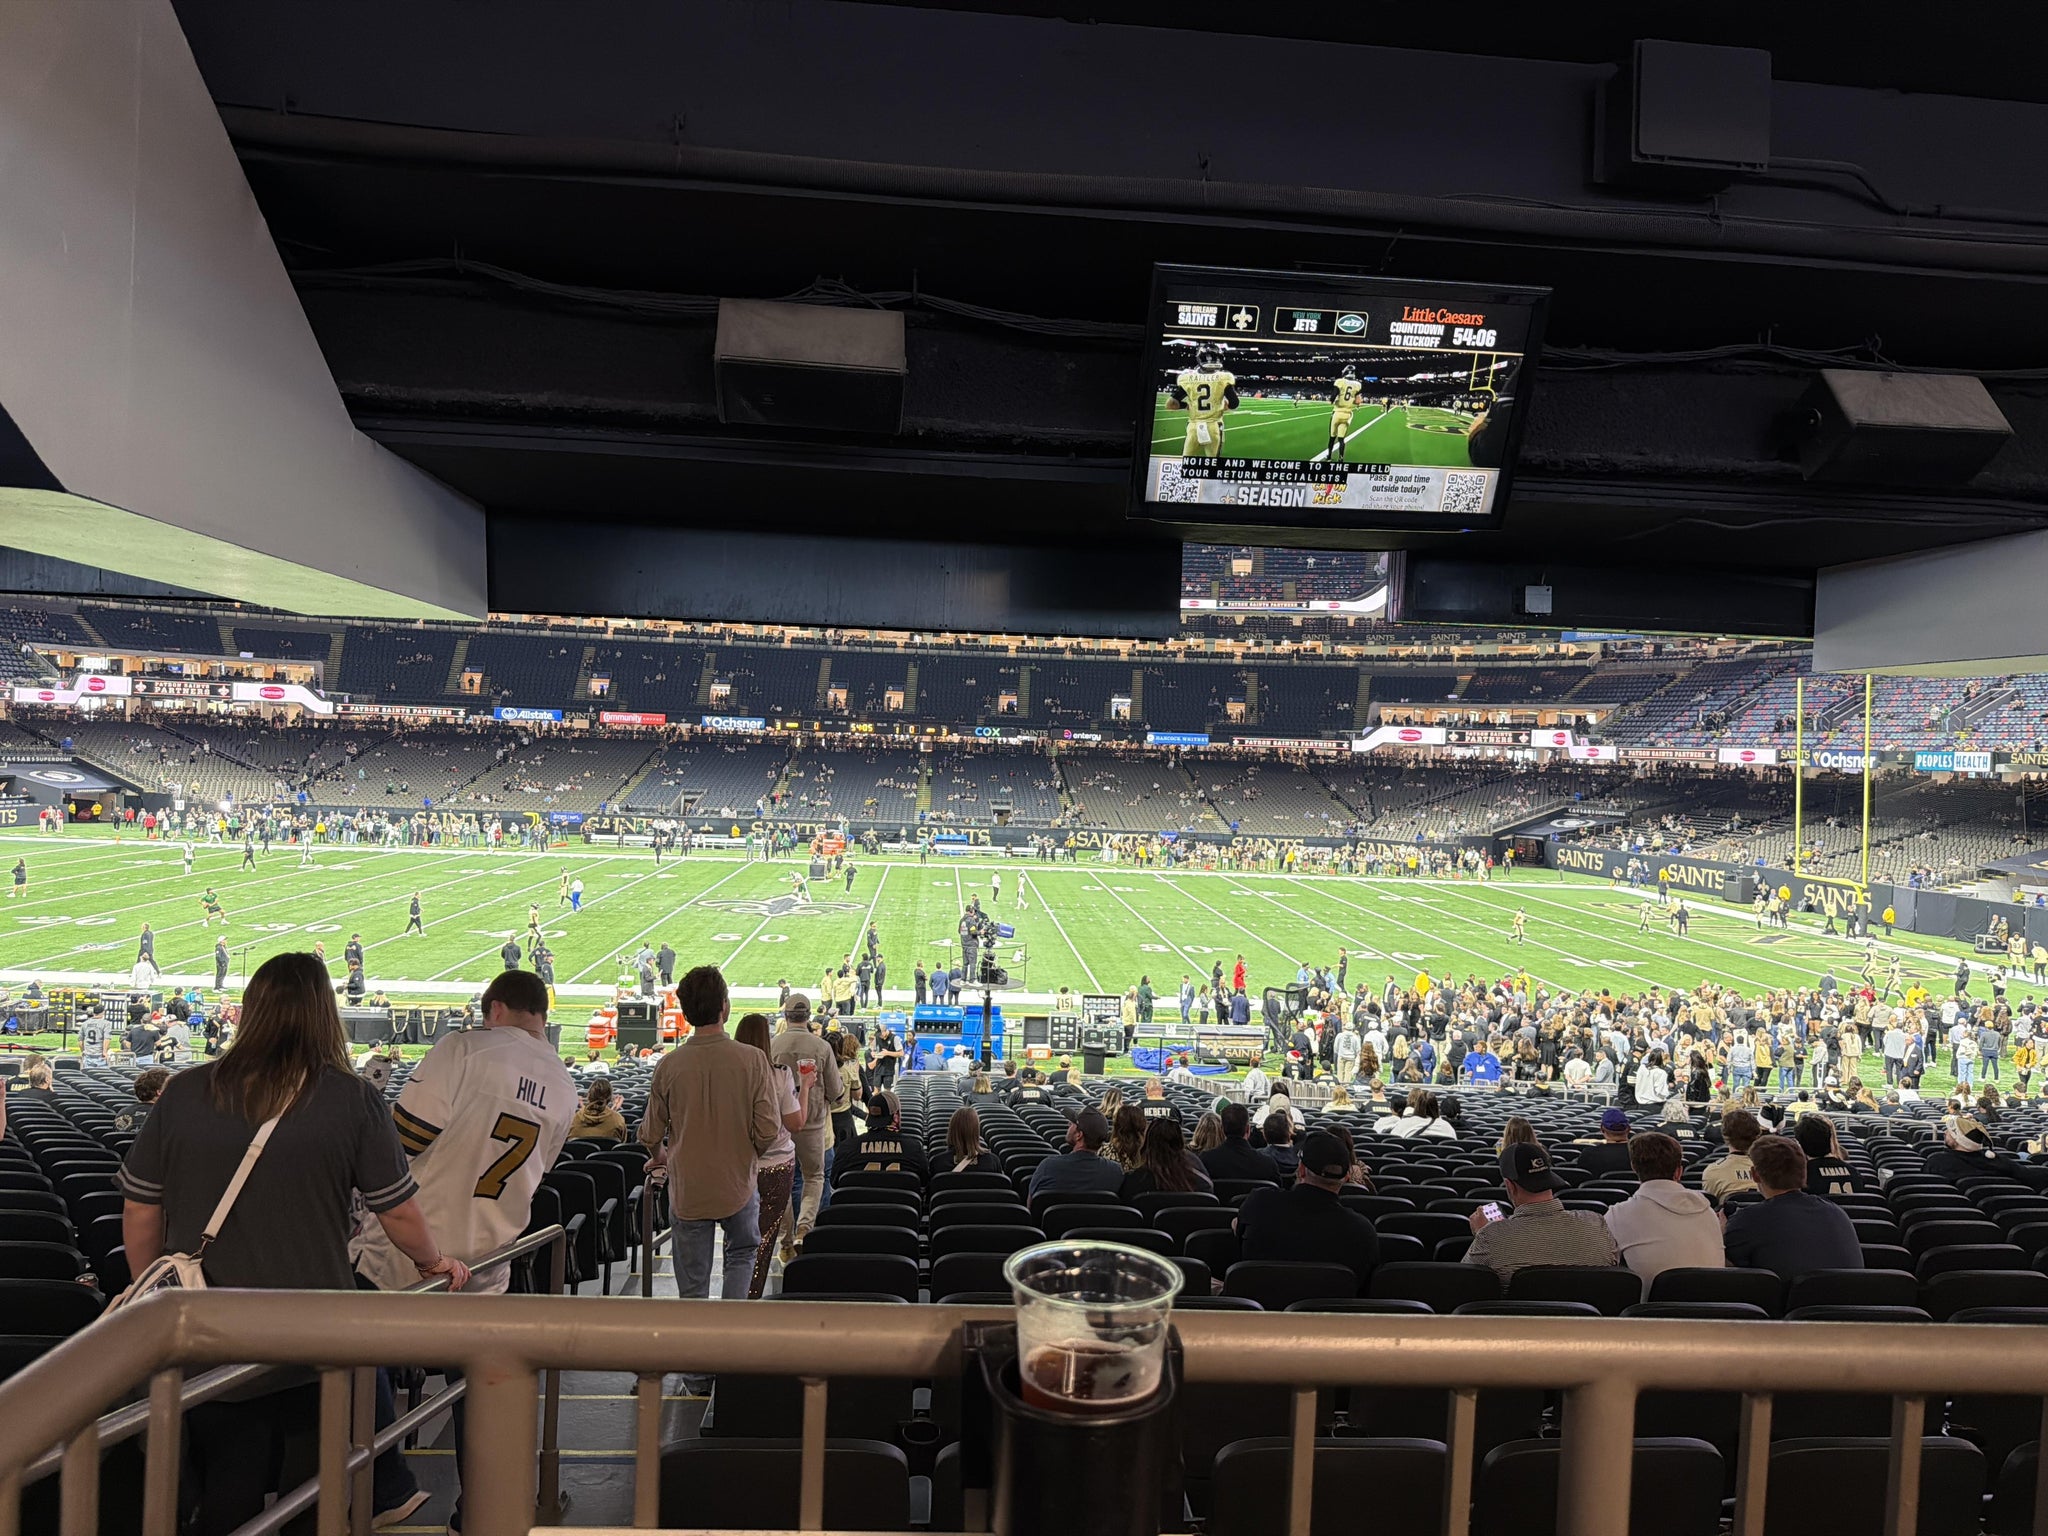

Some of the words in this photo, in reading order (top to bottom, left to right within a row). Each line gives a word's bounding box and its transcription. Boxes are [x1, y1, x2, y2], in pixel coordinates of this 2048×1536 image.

[1178, 312, 1217, 327] SAINTS
[1292, 311, 1305, 320] NEW
[1305, 312, 1321, 320] YORK
[1402, 306, 1436, 323] Little
[1437, 308, 1484, 326] Caesars
[1293, 319, 1318, 332] JETS
[1390, 322, 1444, 336] COUNTDOWN
[1390, 335, 1402, 346] TO
[1402, 335, 1440, 348] KICKOFF
[1452, 327, 1497, 347] 54:06
[1197, 384, 1211, 411] 2
[1343, 387, 1353, 402] 6
[1183, 457, 1218, 467] NOISE
[1225, 459, 1245, 468] AND
[1252, 460, 1301, 470] WELCOME
[1309, 462, 1322, 471] TO
[1330, 463, 1349, 472] THE
[1357, 464, 1391, 474] FIELD
[1181, 469, 1209, 478] YOUR
[1217, 470, 1258, 480] RETURN
[1265, 472, 1346, 483] SPECIALISTS.
[1369, 474, 1387, 482] Pass
[1394, 474, 1412, 484] good
[1414, 475, 1431, 483] time
[1372, 484, 1399, 493] outside
[1401, 485, 1426, 495] today?
[1237, 486, 1306, 507] SEASON
[1239, 632, 1267, 640] SAINTS
[1302, 633, 1330, 641] SAINTS
[1430, 633, 1460, 641] SAINTS
[1497, 632, 1527, 640] SAINTS
[154, 687, 210, 696] PARTNERS
[565, 712, 596, 721] SAINTS
[603, 712, 642, 723] Community
[712, 717, 763, 728] Ochsner
[975, 727, 1000, 737] COX
[1073, 733, 1101, 741] entergy
[1917, 754, 1952, 768] PEOPLES
[1955, 754, 1988, 769] HEALTH
[2010, 753, 2048, 765] SAINTS
[1557, 848, 1604, 871] SAINTS
[1668, 863, 1725, 890] SAINTS
[88, 1030, 97, 1045] 9
[1225, 1049, 1262, 1058] SAINTS
[516, 1076, 547, 1111] HILL
[1143, 1107, 1171, 1118] HEBERT
[861, 1141, 903, 1154] KAMARA
[474, 1112, 541, 1200] 7
[1819, 1167, 1850, 1177] KAMARA
